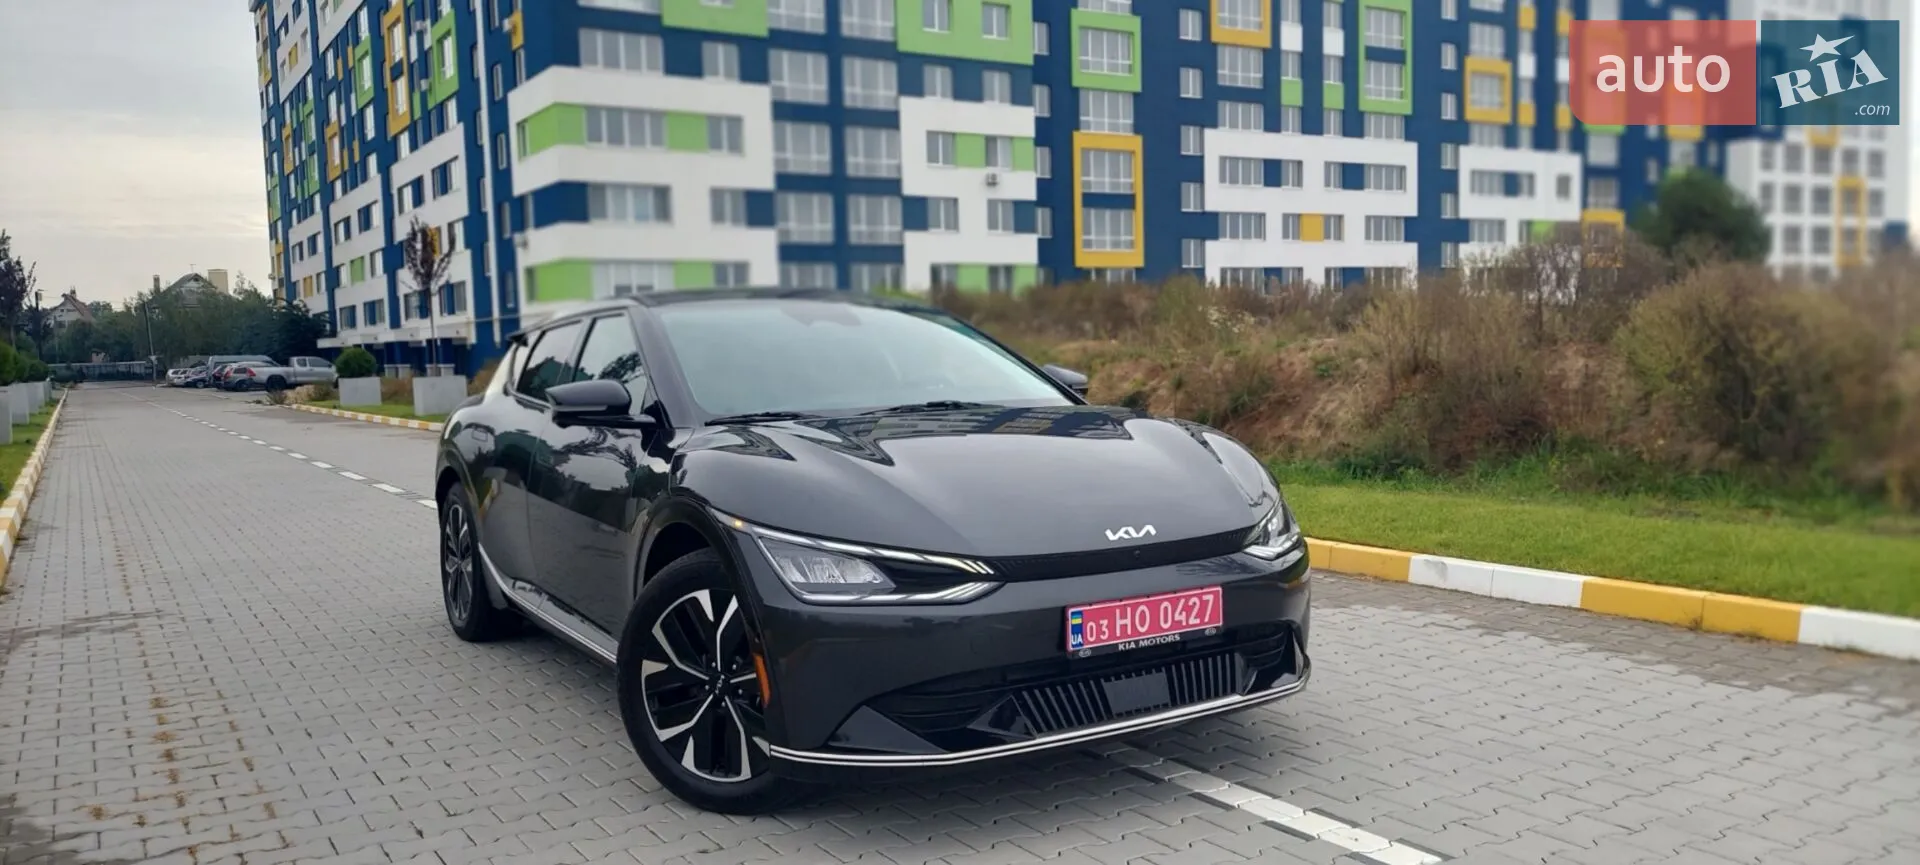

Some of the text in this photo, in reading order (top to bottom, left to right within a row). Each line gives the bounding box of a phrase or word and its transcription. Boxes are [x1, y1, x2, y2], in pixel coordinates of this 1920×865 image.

[1104, 524, 1157, 541] KIA
[1086, 620, 1109, 642] 03
[1159, 594, 1215, 630] 0427
[1071, 633, 1083, 645] UA
[1118, 634, 1180, 651] KIA MOTORS
